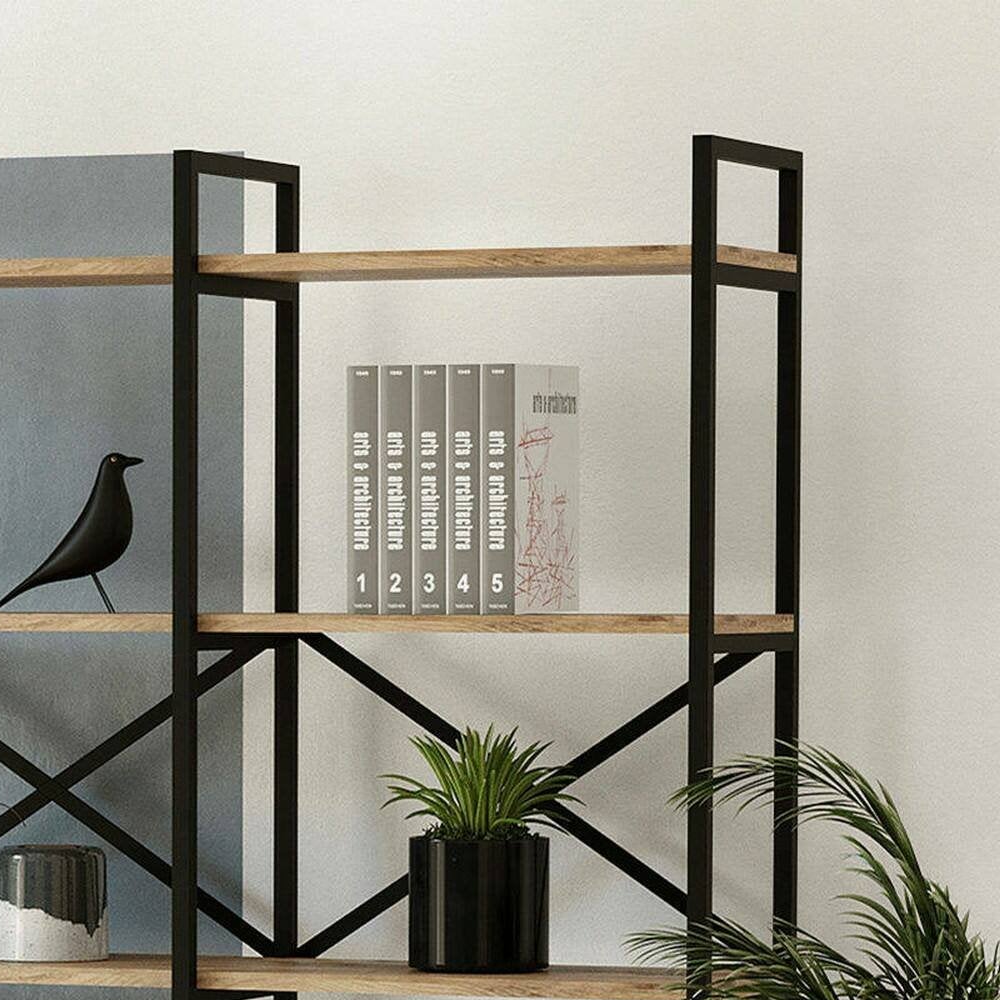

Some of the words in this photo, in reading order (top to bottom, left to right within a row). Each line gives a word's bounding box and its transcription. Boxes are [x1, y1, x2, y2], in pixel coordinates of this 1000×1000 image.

[353, 432, 372, 456] arts
[387, 432, 405, 456] arts
[421, 432, 439, 456] arts
[455, 431, 473, 455] arts
[488, 431, 507, 455] arts
[353, 476, 373, 550] architecture
[387, 476, 407, 550] architecture
[421, 476, 440, 550] architecture
[455, 475, 474, 550] architecture
[488, 475, 508, 550] architecture
[356, 573, 366, 593] 1
[388, 573, 402, 593] 2
[422, 573, 436, 593] 3
[456, 573, 471, 593] 4
[490, 573, 504, 593] 5
